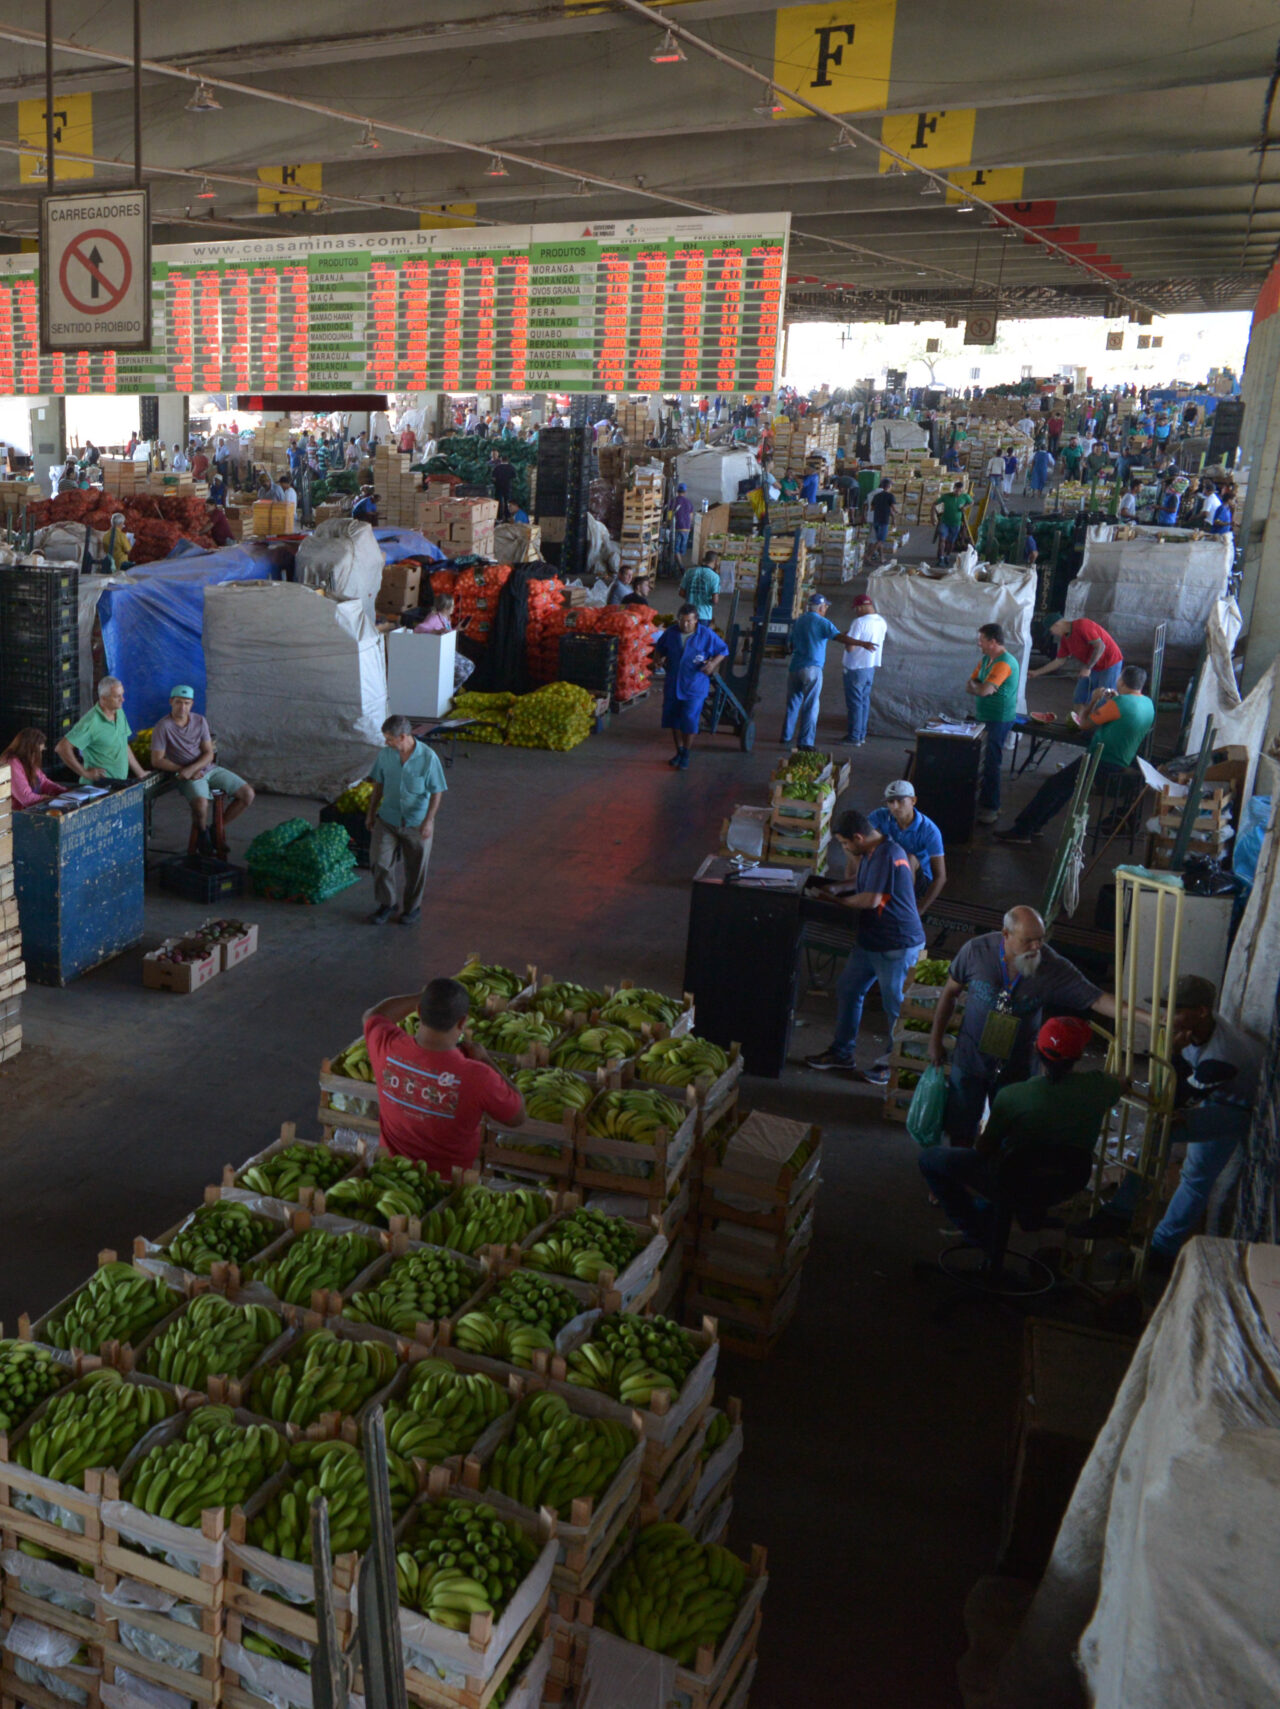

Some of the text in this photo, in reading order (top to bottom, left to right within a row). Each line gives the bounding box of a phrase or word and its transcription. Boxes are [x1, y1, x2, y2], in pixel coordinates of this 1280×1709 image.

[810, 23, 855, 87] F
[911, 112, 946, 149] F
[51, 204, 141, 221] CARREGADORES
[193, 233, 437, 256] www.ceasaminas.com.br
[722, 240, 736, 248] SP
[540, 247, 586, 258] PRODUTOS
[318, 257, 358, 267] PRODUTOS
[533, 265, 575, 274] MORANGA
[310, 274, 344, 282] LARANJA
[531, 275, 574, 284] MORANGO
[531, 286, 580, 296] OVOS GRANJA
[531, 297, 562, 305] PEPINO
[531, 308, 556, 316] PERA
[51, 320, 141, 334] SENTIDO PROIBIDO
[530, 330, 562, 339] QUIABO
[529, 340, 568, 348] REPOLHO
[529, 350, 577, 359] TANGERINA
[529, 360, 561, 369] TOMATE
[529, 371, 550, 379] UVA
[528, 380, 560, 389] VAGEM
